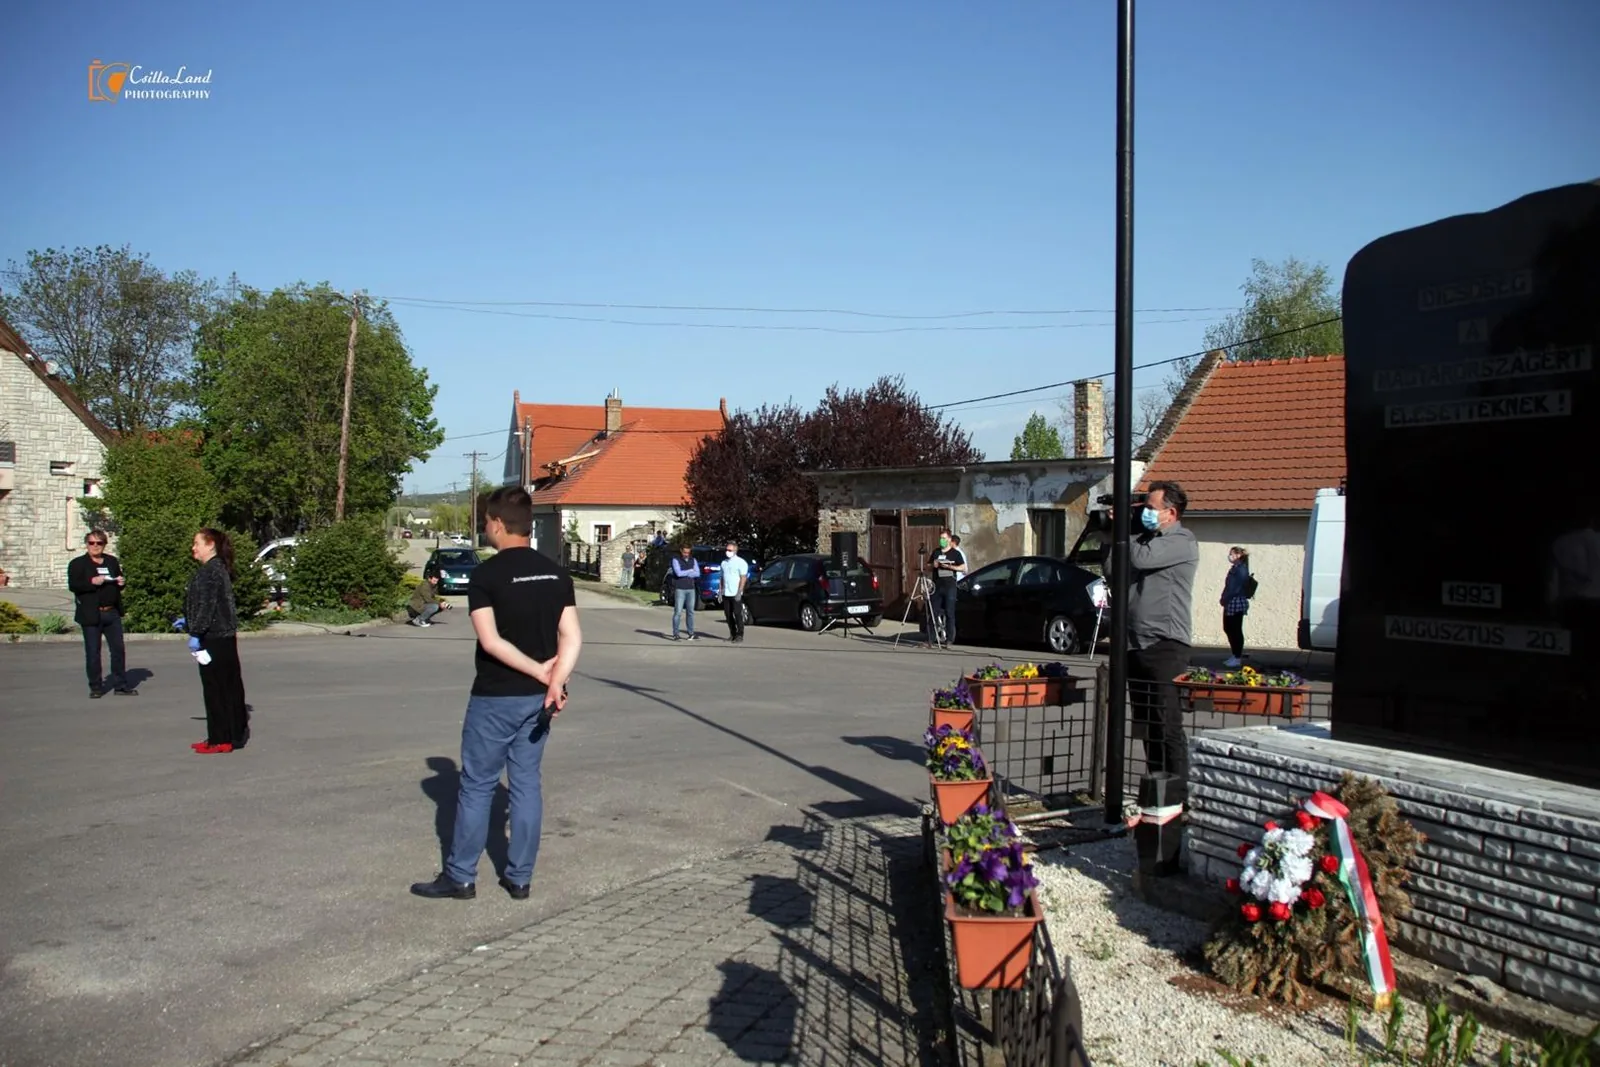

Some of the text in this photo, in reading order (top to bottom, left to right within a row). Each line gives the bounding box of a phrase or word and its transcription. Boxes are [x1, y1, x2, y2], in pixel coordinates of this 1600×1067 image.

[1465, 320, 1480, 341] A
[1447, 583, 1496, 604] 1993
[1389, 618, 1564, 651] AUGUSZTUS 20.
